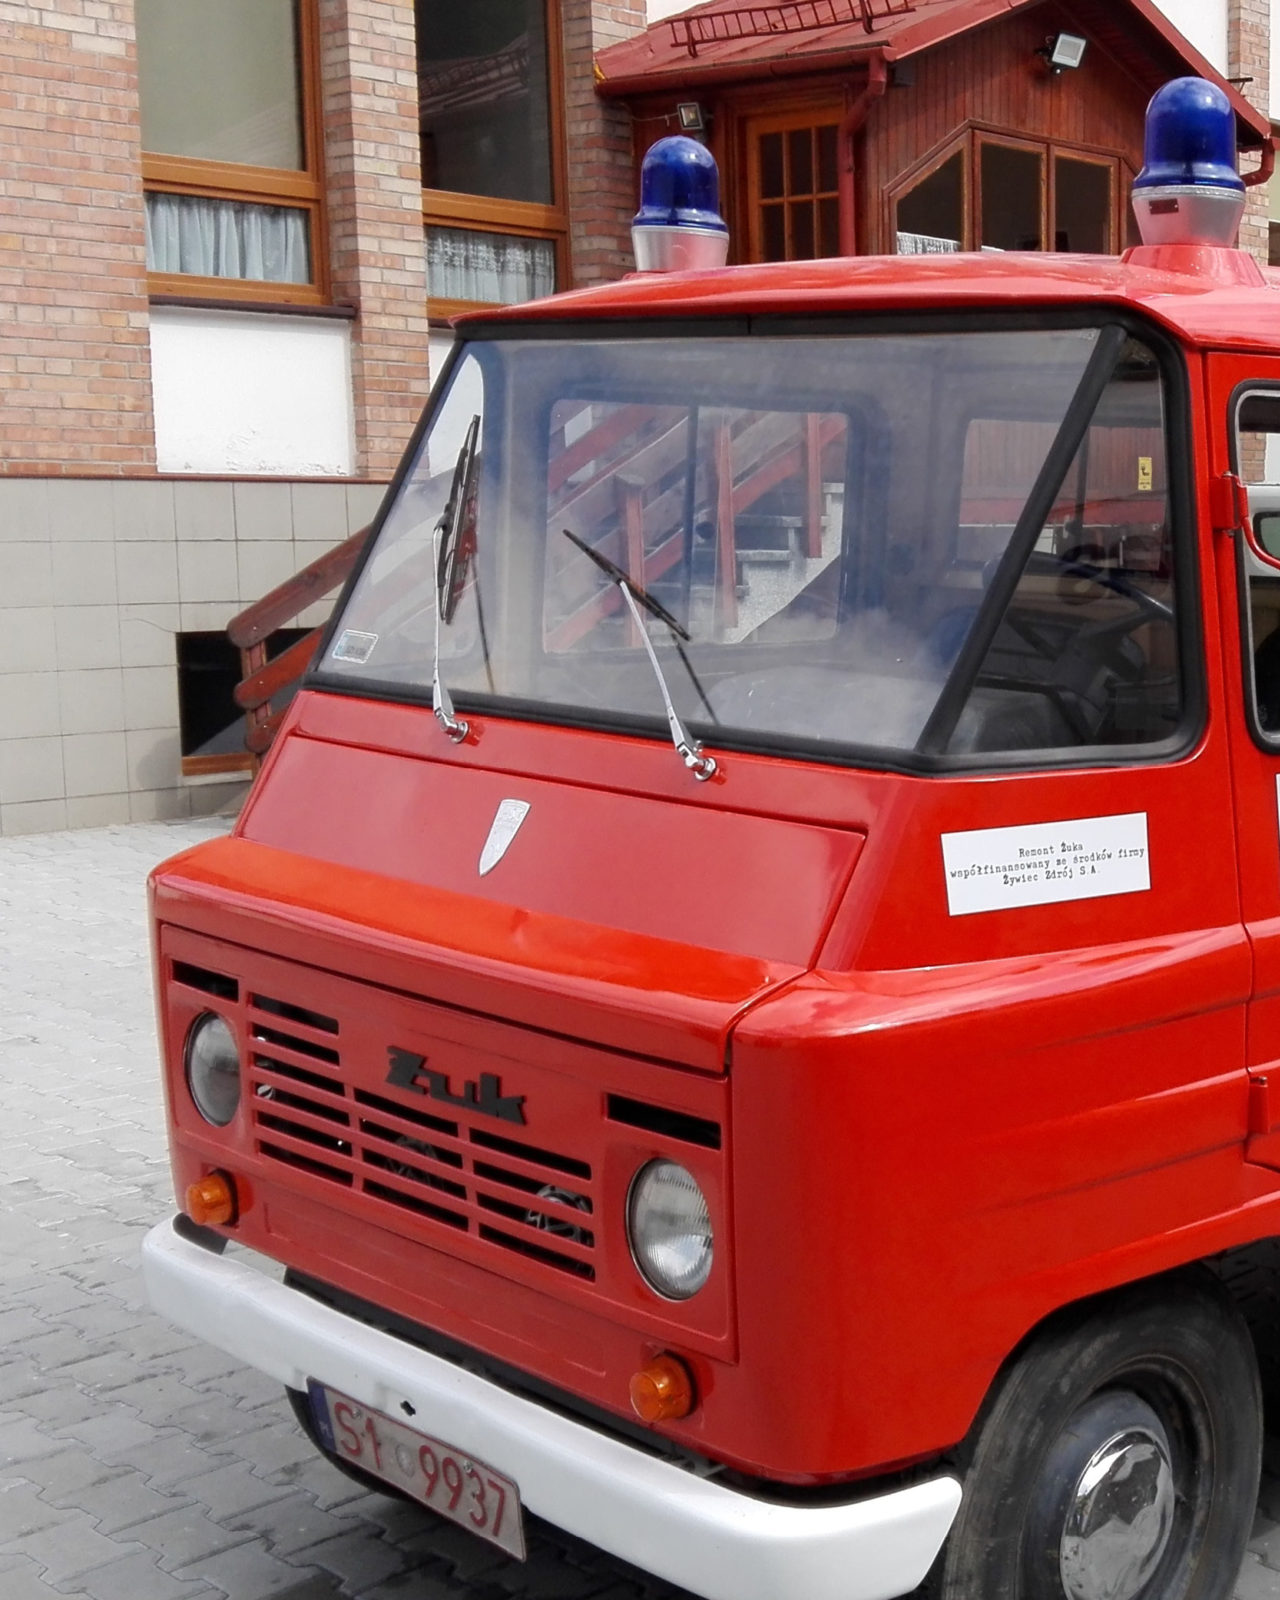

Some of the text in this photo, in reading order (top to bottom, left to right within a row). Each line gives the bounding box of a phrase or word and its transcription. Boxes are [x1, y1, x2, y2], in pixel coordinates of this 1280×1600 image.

[1019, 842, 1084, 858] Remont Żuka
[1073, 850, 1113, 865] środków
[1003, 870, 1038, 887] Żywiec
[1045, 866, 1073, 880] Zdrój
[418, 1444, 506, 1537] 9937
